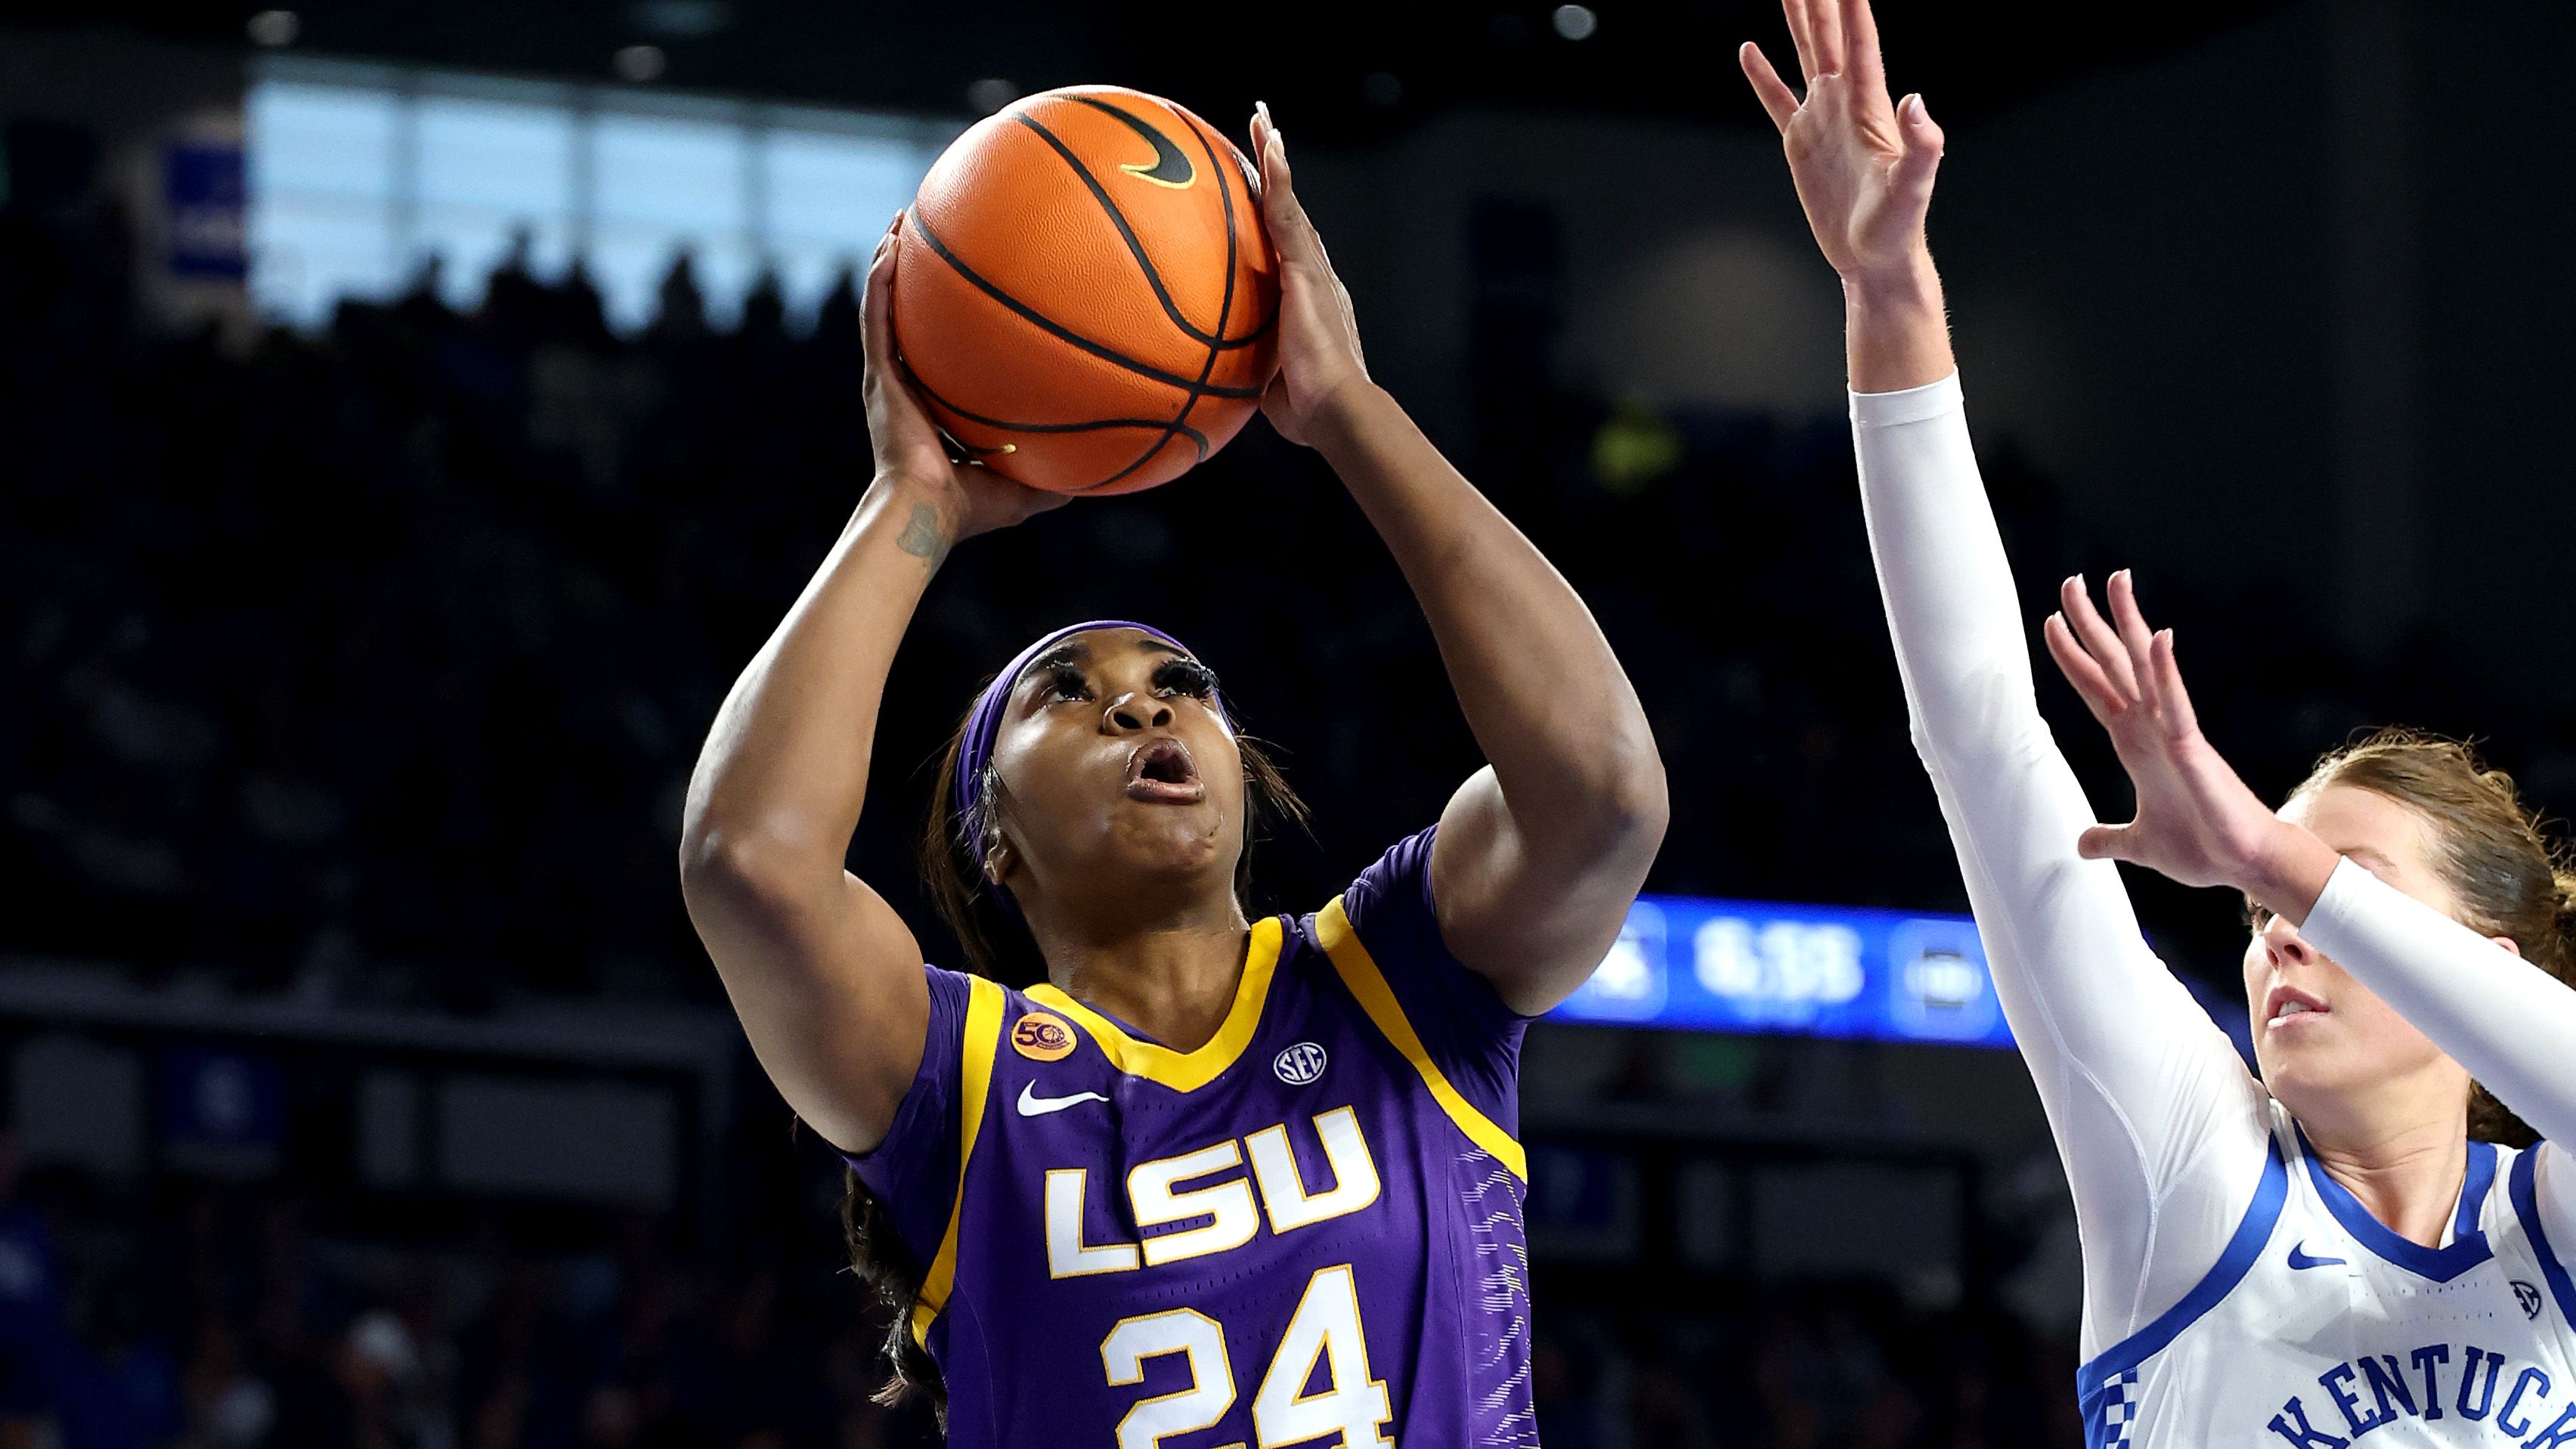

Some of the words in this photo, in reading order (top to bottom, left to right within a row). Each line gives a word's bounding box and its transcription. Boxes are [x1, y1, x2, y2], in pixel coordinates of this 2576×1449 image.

[1015, 1022, 1065, 1046] 50
[1278, 1045, 1322, 1081] SEC
[1045, 1105, 1381, 1279] LSU
[1100, 1263, 1395, 1449] 24
